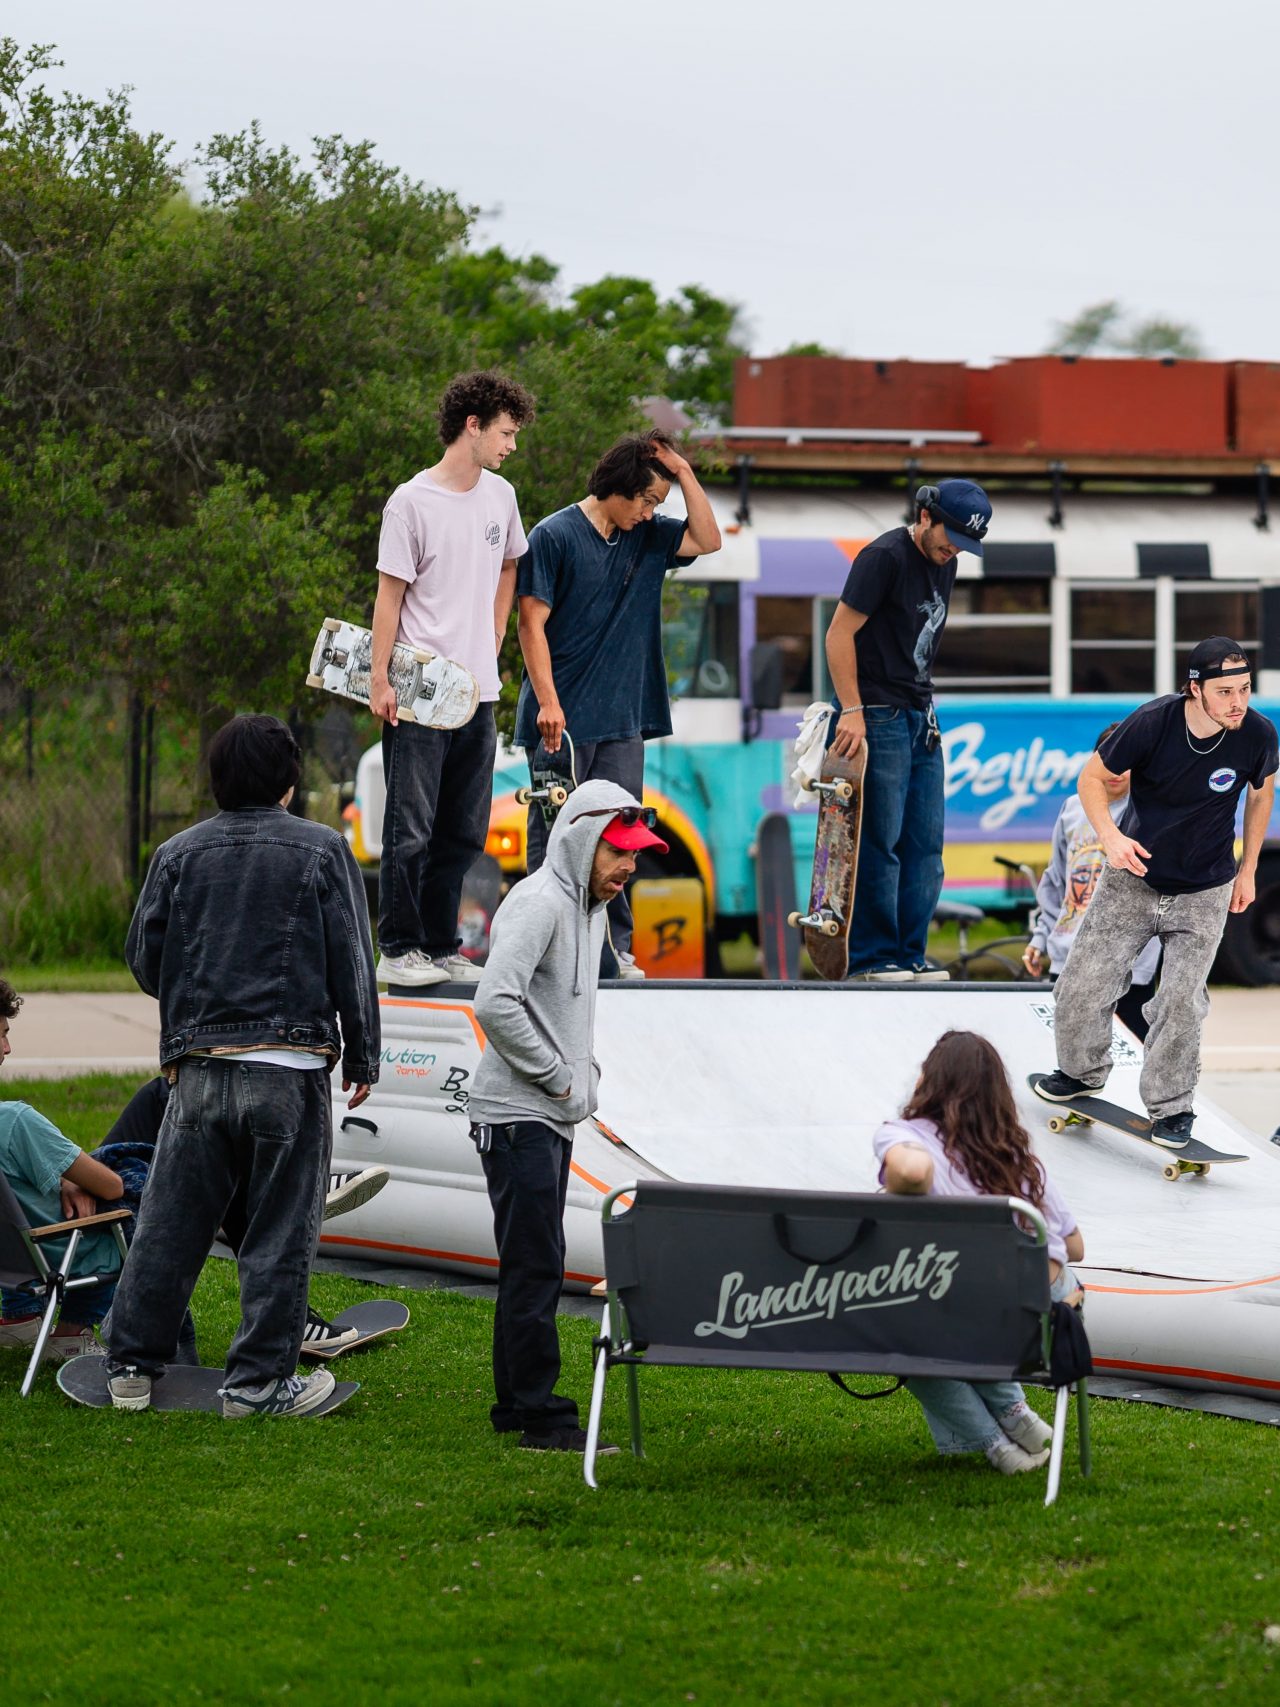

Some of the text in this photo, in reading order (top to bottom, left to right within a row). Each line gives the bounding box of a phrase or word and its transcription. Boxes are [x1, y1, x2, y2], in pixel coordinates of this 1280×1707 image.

[941, 721, 1096, 832] Beyon
[379, 1046, 436, 1065] lution
[694, 1242, 960, 1340] Landyachtz
